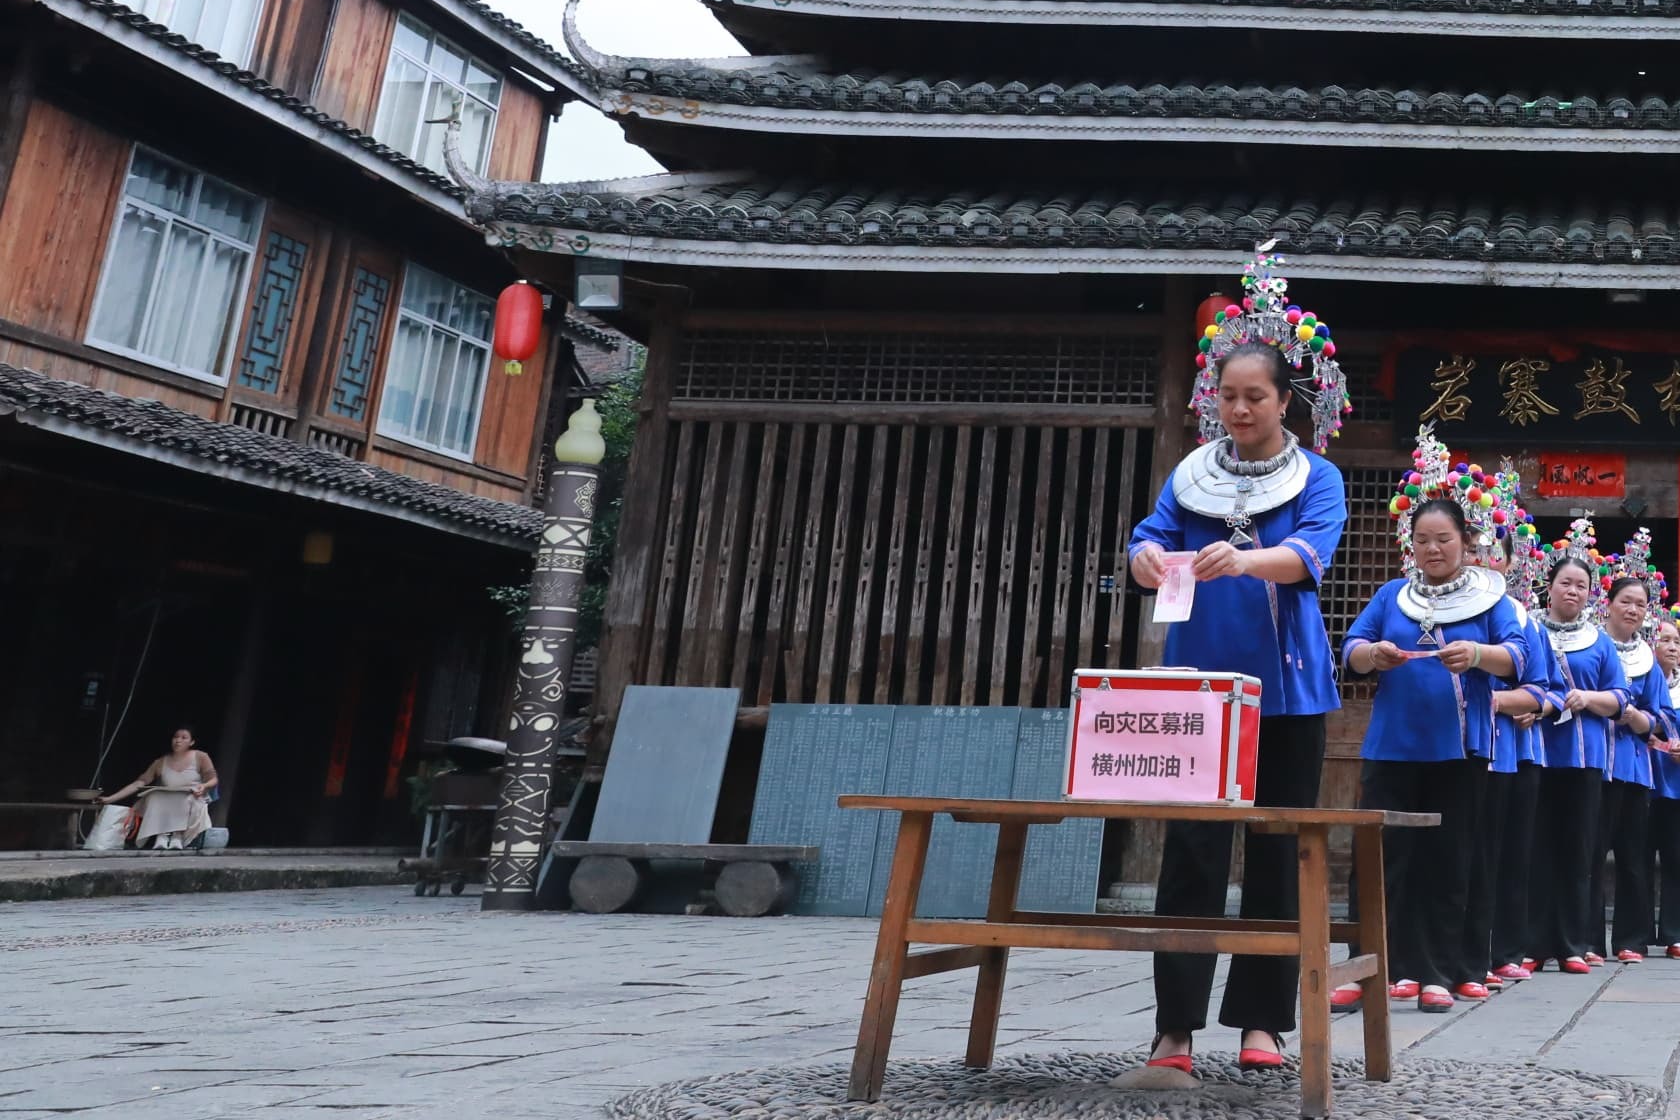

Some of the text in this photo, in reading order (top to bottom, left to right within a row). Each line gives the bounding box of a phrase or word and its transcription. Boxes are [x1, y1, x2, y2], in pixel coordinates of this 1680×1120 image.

[1093, 711, 1205, 736] 向灾区募捐
[1091, 753, 1196, 779] 横州加油！
